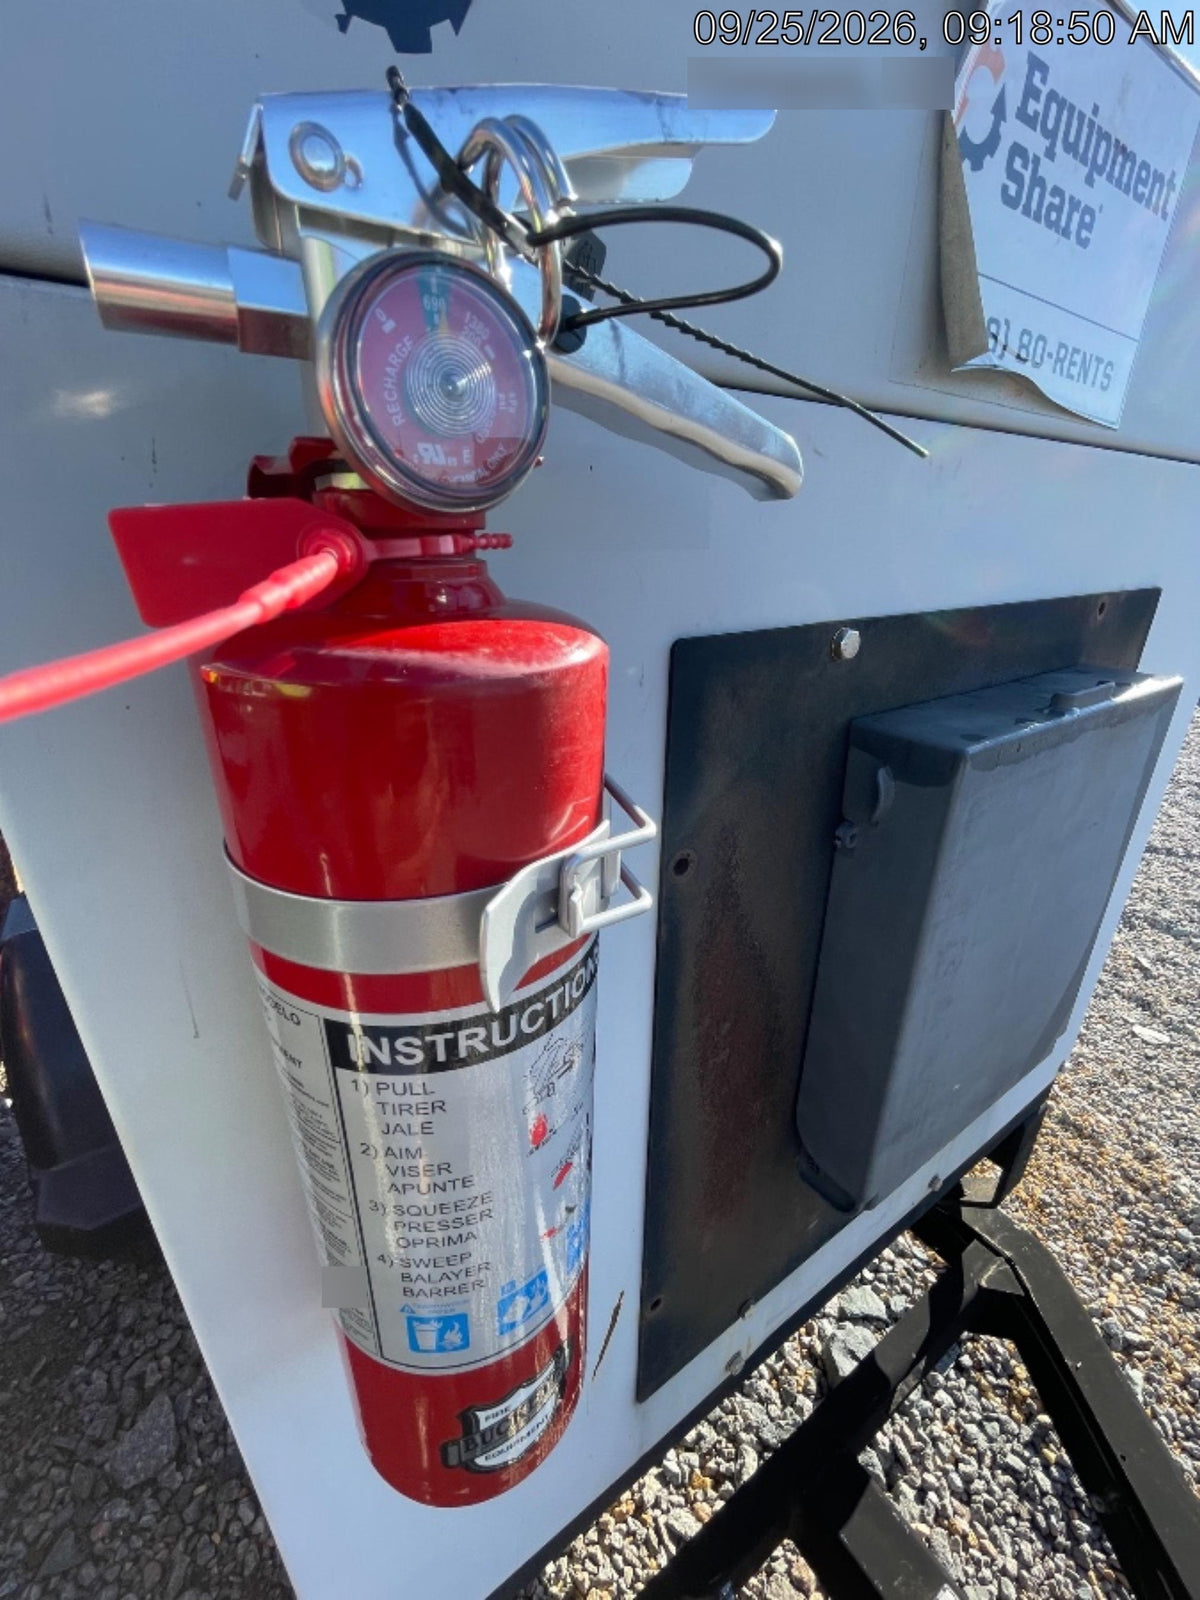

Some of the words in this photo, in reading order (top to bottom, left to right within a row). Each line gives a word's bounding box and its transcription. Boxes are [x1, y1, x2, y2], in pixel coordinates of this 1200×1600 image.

[1015, 50, 1178, 222] Equipment
[1000, 141, 1098, 250] Share
[1015, 327, 1115, 392] 80-RENTS
[383, 335, 415, 428] RECHARGE
[350, 1079, 369, 1097] 1)
[376, 1079, 435, 1098] PULL
[379, 1099, 447, 1117] TIRER
[381, 1120, 435, 1137] JALE
[360, 1141, 379, 1160] 2)
[384, 1146, 423, 1160] AIM
[386, 1161, 453, 1179] VISER
[388, 1174, 476, 1196] APUNTE
[368, 1199, 388, 1217] 3)
[395, 1191, 494, 1217] SQUEEZE
[393, 1208, 494, 1234] PRESSER
[396, 1231, 478, 1250] OPRIMA
[376, 1253, 395, 1268] 4)
[400, 1251, 473, 1269] SWEEP
[401, 1260, 492, 1284] BALAYER
[403, 1279, 486, 1299] BARRER
